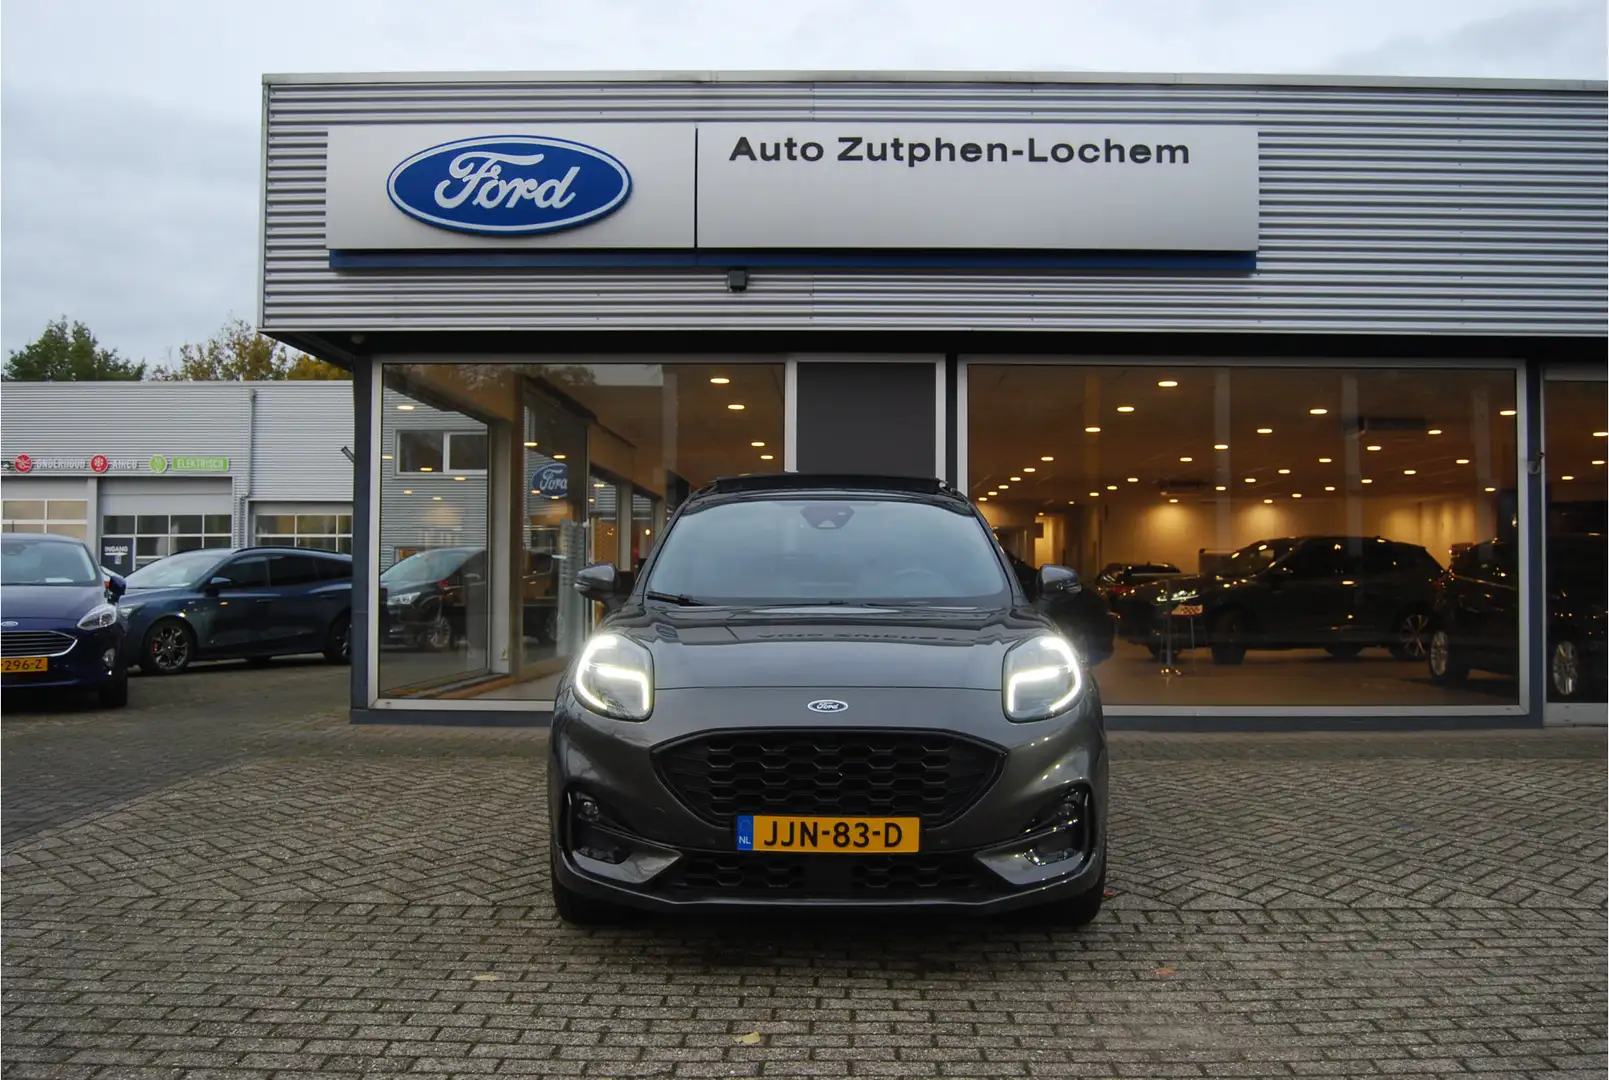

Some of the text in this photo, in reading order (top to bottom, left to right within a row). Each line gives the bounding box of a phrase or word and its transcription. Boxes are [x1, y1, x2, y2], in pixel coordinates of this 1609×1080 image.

[729, 137, 1190, 167] Auto Zutphen-Lochem
[434, 151, 580, 208] Ford
[816, 702, 839, 710] Ford
[738, 835, 751, 845] NL
[763, 820, 903, 848] JJN-83-D
